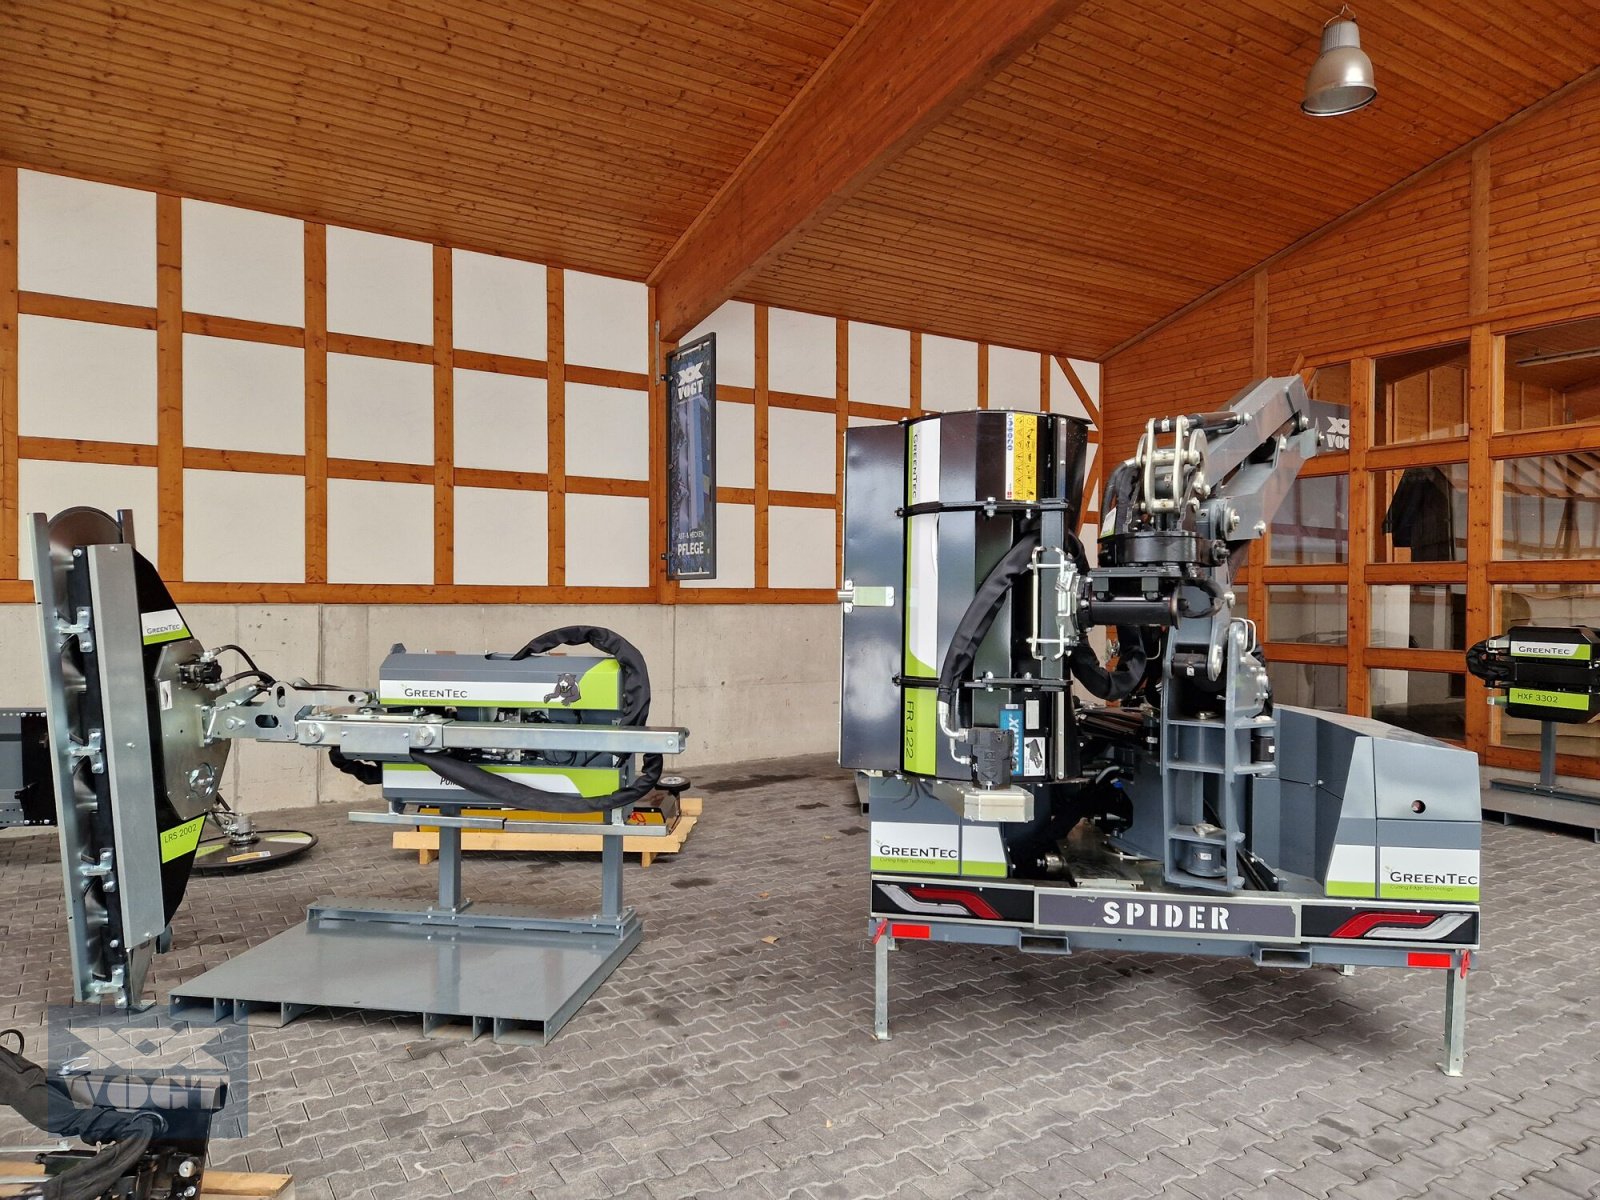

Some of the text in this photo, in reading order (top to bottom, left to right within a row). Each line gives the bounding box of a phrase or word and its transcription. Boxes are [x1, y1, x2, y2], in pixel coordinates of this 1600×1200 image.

[678, 379, 704, 400] VOGT
[677, 541, 704, 556] PFLEGE
[1517, 692, 1559, 703] HXF 3302
[905, 700, 915, 759] FR 122
[164, 823, 198, 843] LRS 2002
[1102, 900, 1231, 931] SPIDER
